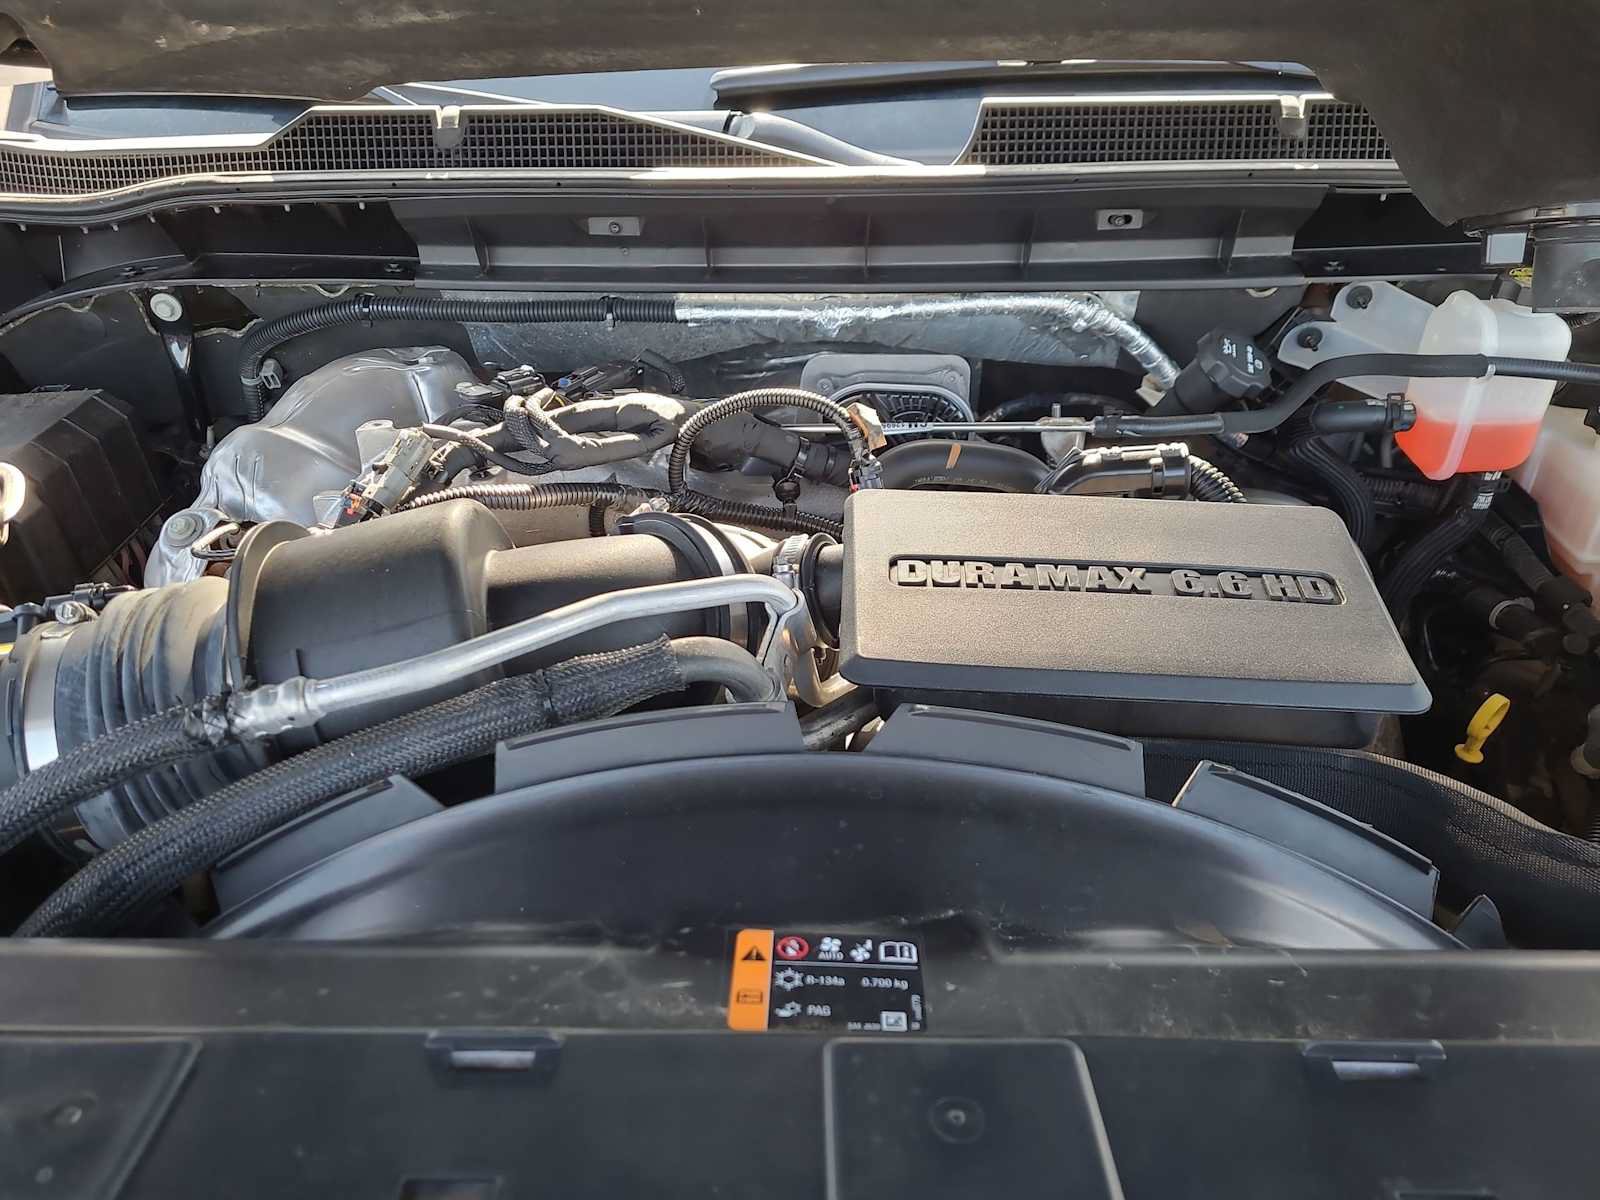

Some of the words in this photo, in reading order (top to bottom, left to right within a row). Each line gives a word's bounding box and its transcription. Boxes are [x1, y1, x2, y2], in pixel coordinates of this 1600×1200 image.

[897, 559, 1152, 594] DURAMAX
[1170, 569, 1253, 599] 6.6
[1261, 573, 1336, 603] HD
[818, 951, 844, 960] AUTO
[805, 975, 846, 986] R-134a
